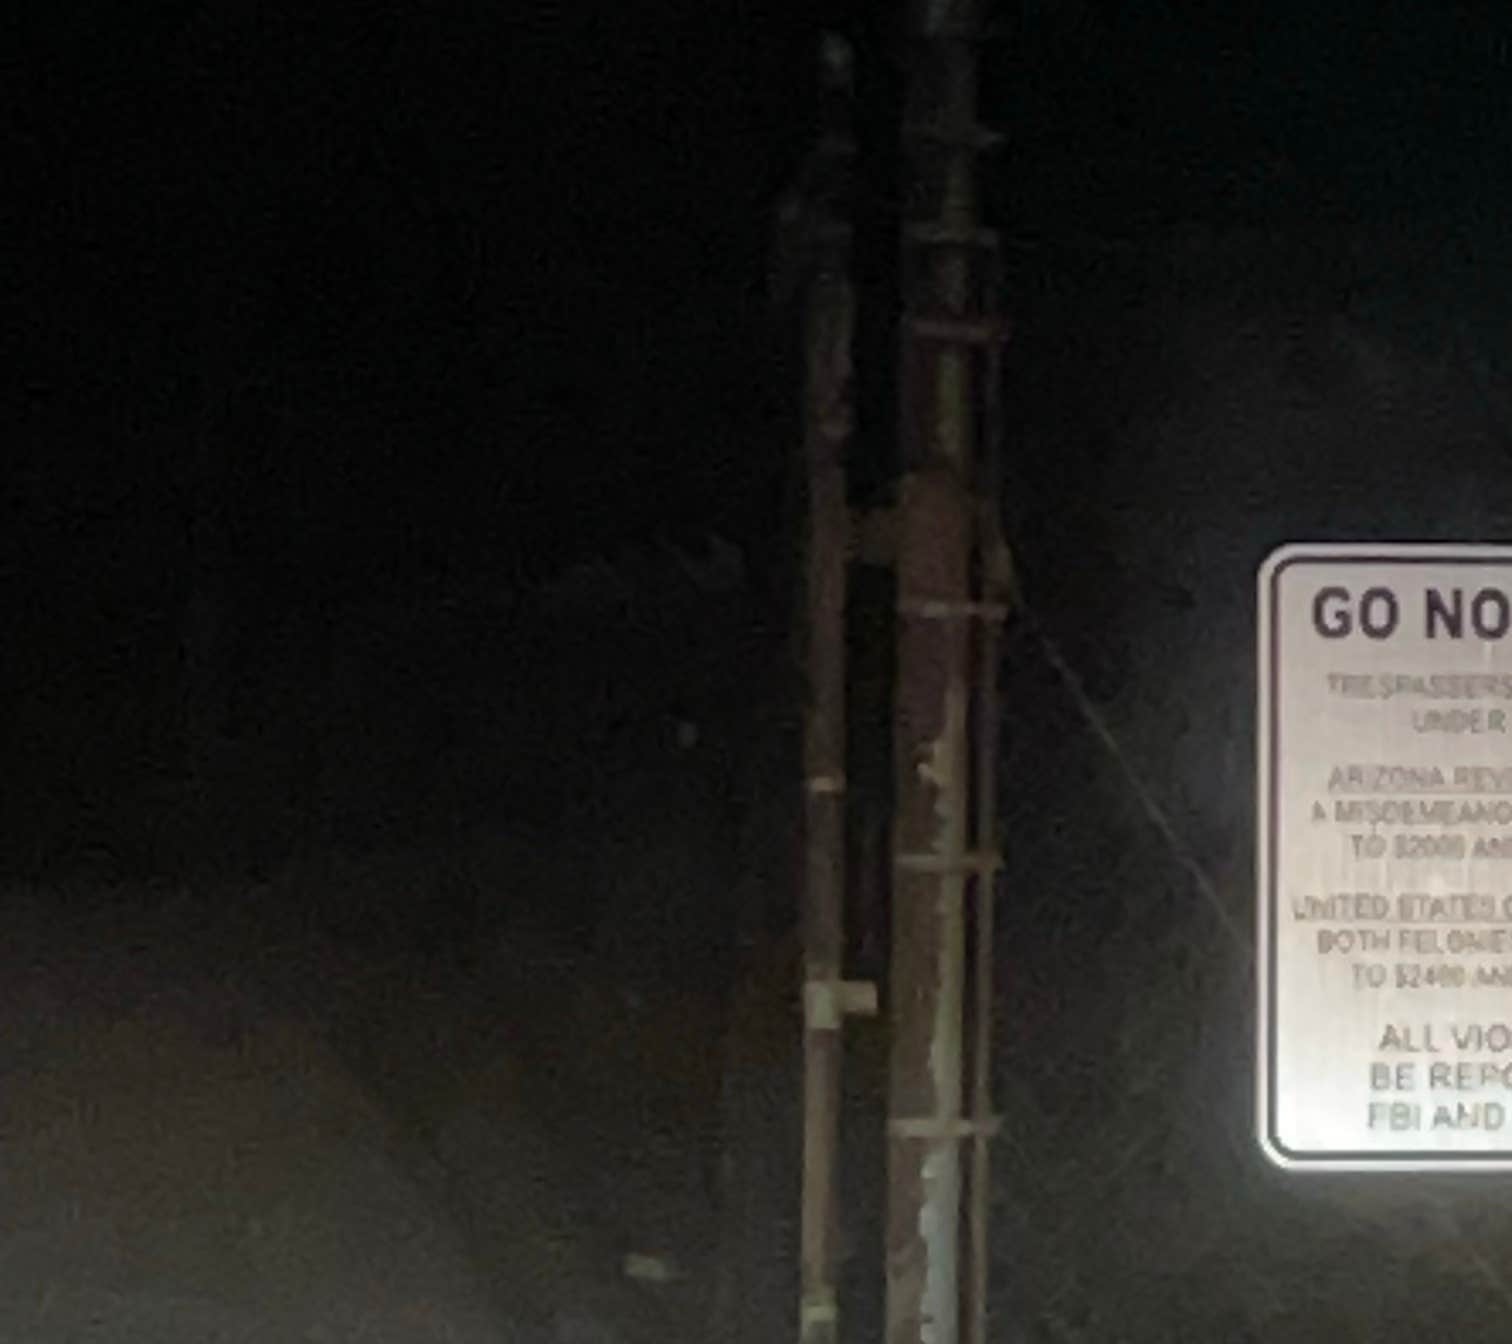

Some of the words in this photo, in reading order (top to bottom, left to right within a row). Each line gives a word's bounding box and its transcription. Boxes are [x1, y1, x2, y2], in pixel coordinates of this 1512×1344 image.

[1310, 585, 1400, 641] GO
[1423, 587, 1512, 643] NO
[1412, 709, 1506, 734] UNDER
[1328, 765, 1447, 794] ARIZONA
[1312, 801, 1327, 822] A
[1350, 833, 1387, 859] TO
[1292, 893, 1391, 922] UNITED
[1395, 893, 1498, 923] STATES
[1317, 929, 1390, 954] BOTH
[1352, 963, 1387, 989] TO
[1378, 1024, 1440, 1053] ALL
[1369, 1062, 1415, 1092] BE
[1367, 1102, 1421, 1131] FBI
[1431, 1102, 1505, 1131] AND
